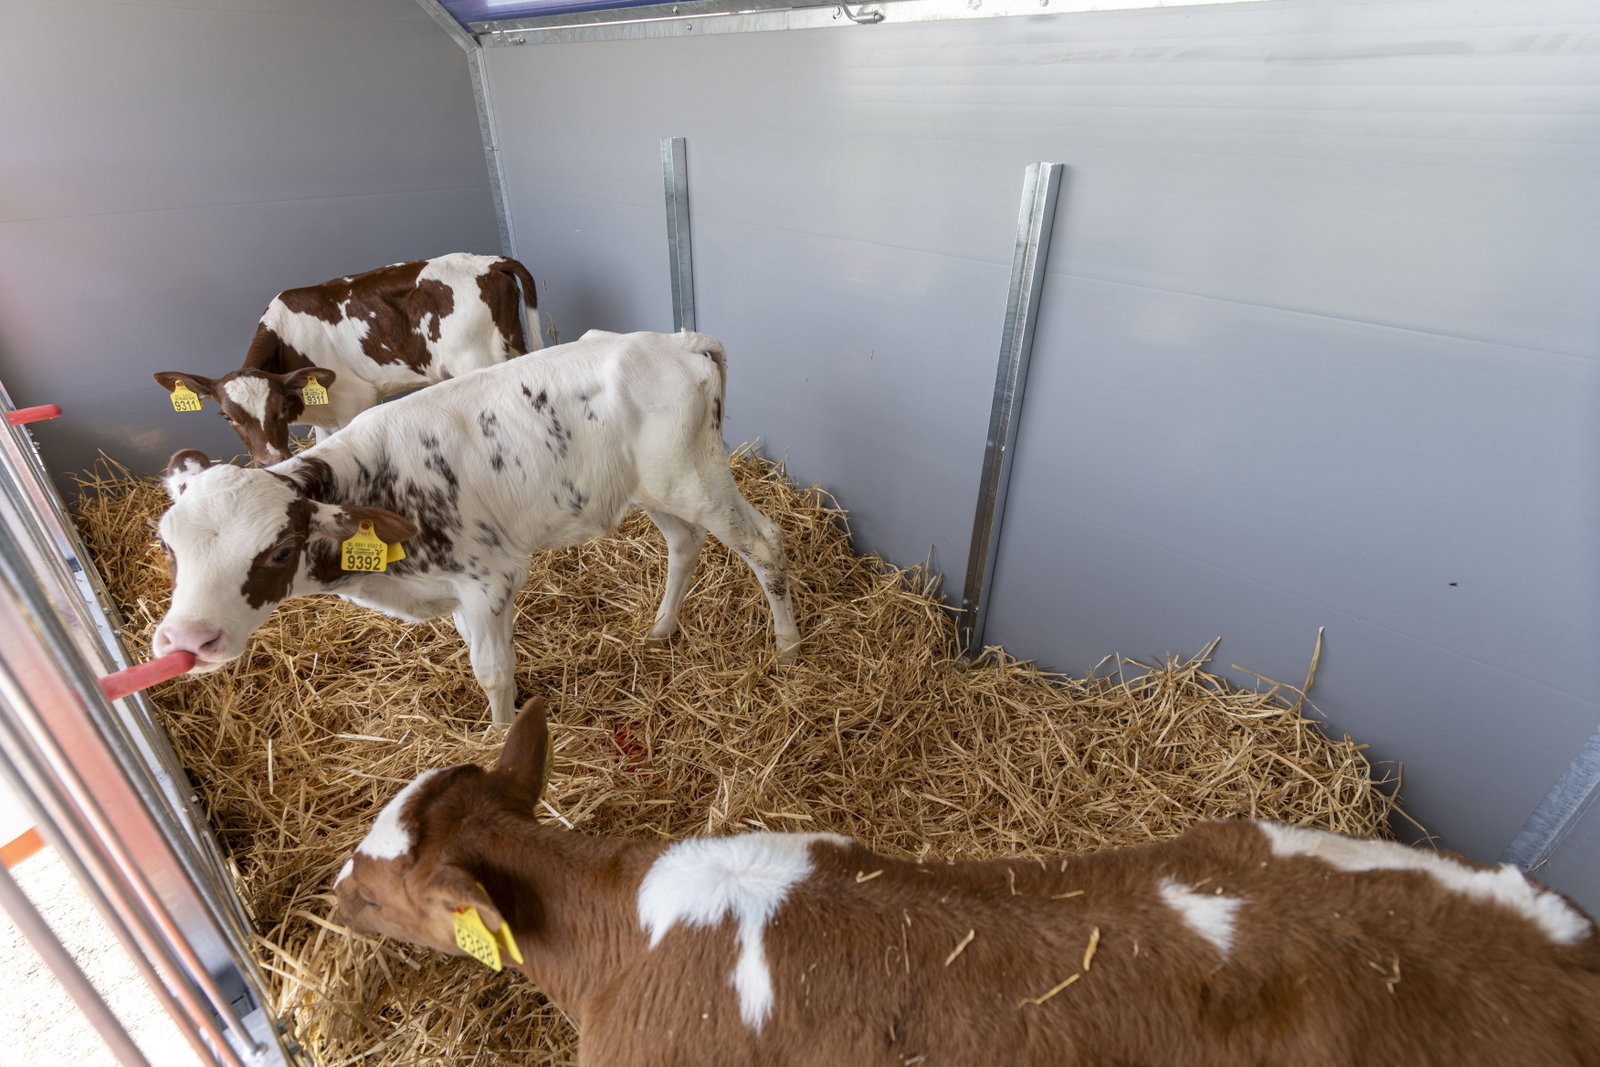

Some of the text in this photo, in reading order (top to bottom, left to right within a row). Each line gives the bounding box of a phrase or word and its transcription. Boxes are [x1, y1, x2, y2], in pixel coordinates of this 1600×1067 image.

[308, 395, 325, 404] 9311
[174, 400, 197, 410] 9311
[347, 555, 381, 570] 9392
